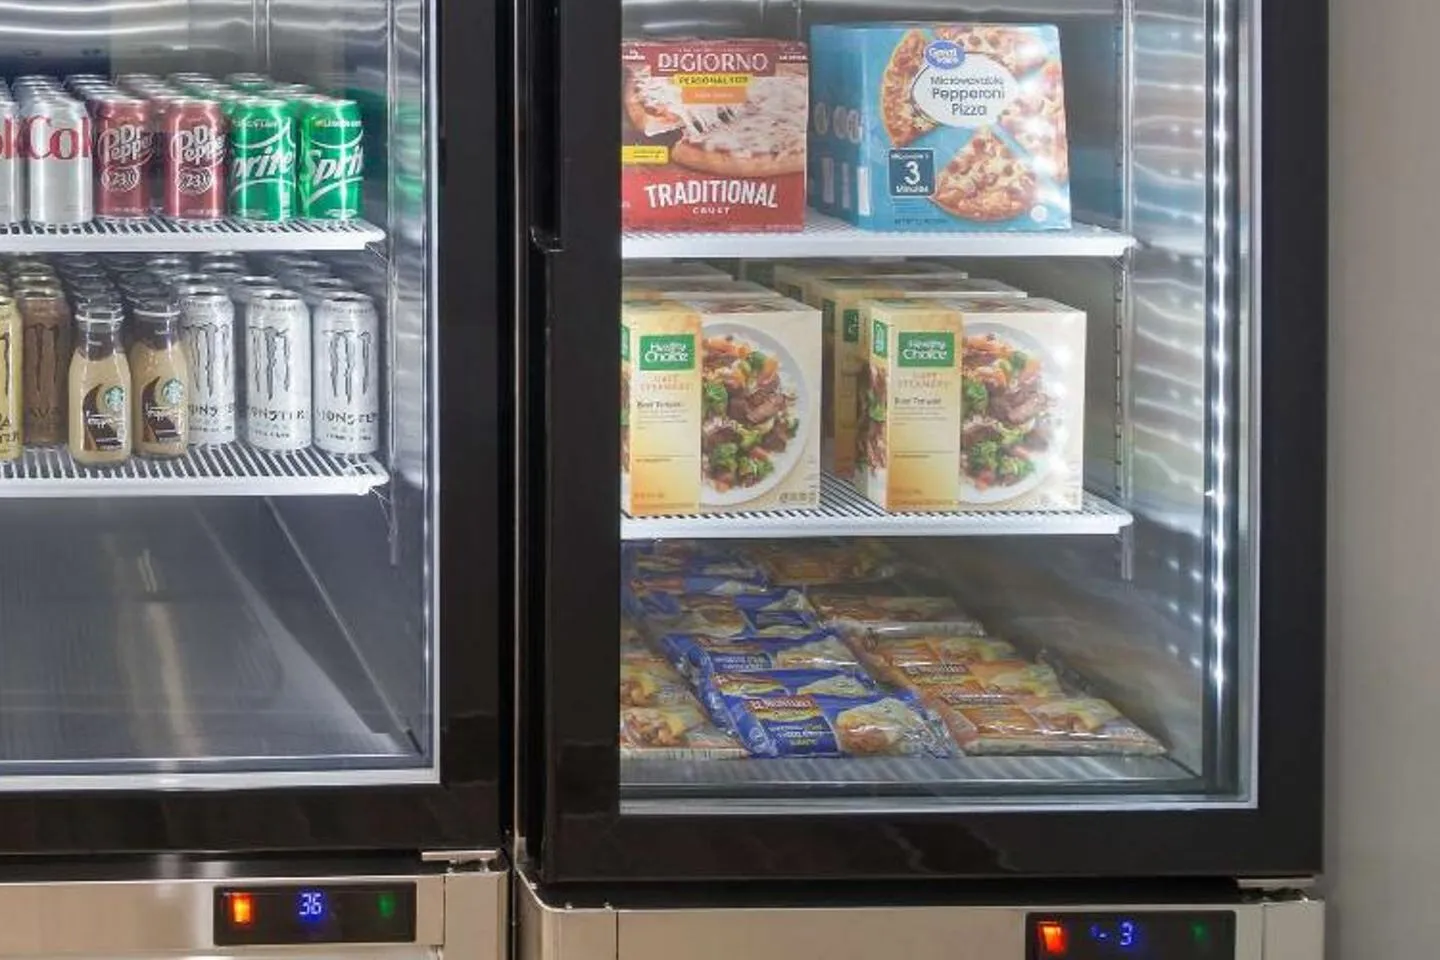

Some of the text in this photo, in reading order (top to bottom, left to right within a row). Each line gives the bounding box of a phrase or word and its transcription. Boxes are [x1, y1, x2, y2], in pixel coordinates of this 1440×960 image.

[932, 87, 1005, 102] Pepperoni
[952, 103, 988, 116] Pizza
[903, 160, 921, 186] 3
[644, 178, 779, 209] TRADITIONAL
[299, 892, 323, 916] 36
